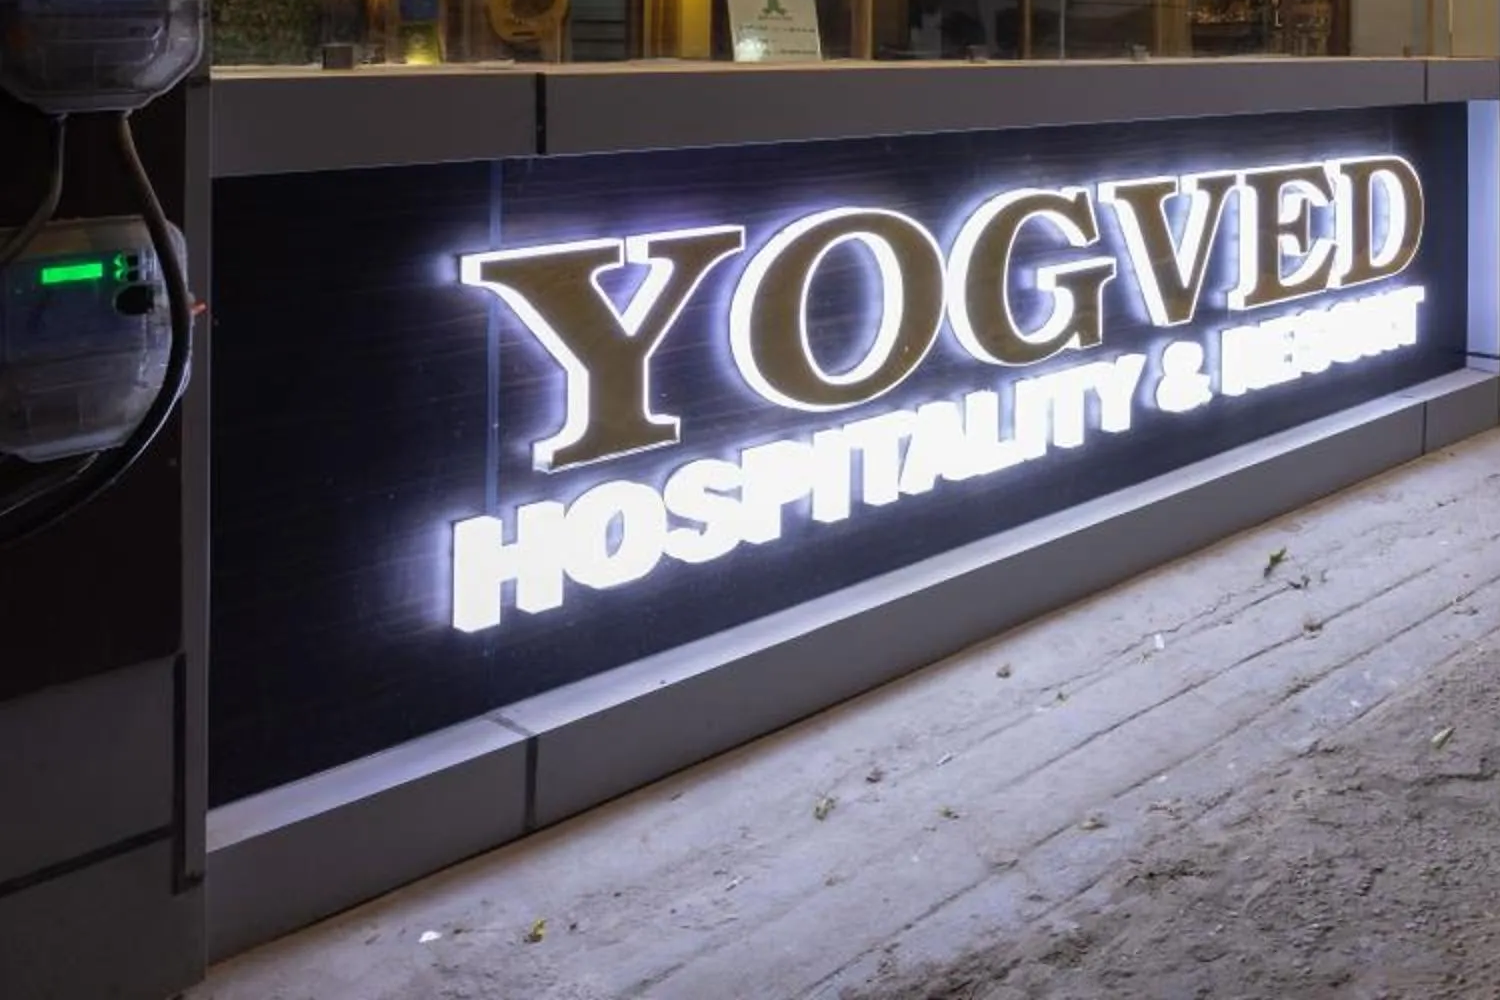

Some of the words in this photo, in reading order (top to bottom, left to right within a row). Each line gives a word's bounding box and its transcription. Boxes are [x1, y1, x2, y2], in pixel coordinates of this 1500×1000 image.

[452, 354, 1146, 634] HOSPITALITY
[1156, 341, 1212, 413] &
[1219, 286, 1425, 397] RESORT
[460, 155, 1425, 473] YOGVED
